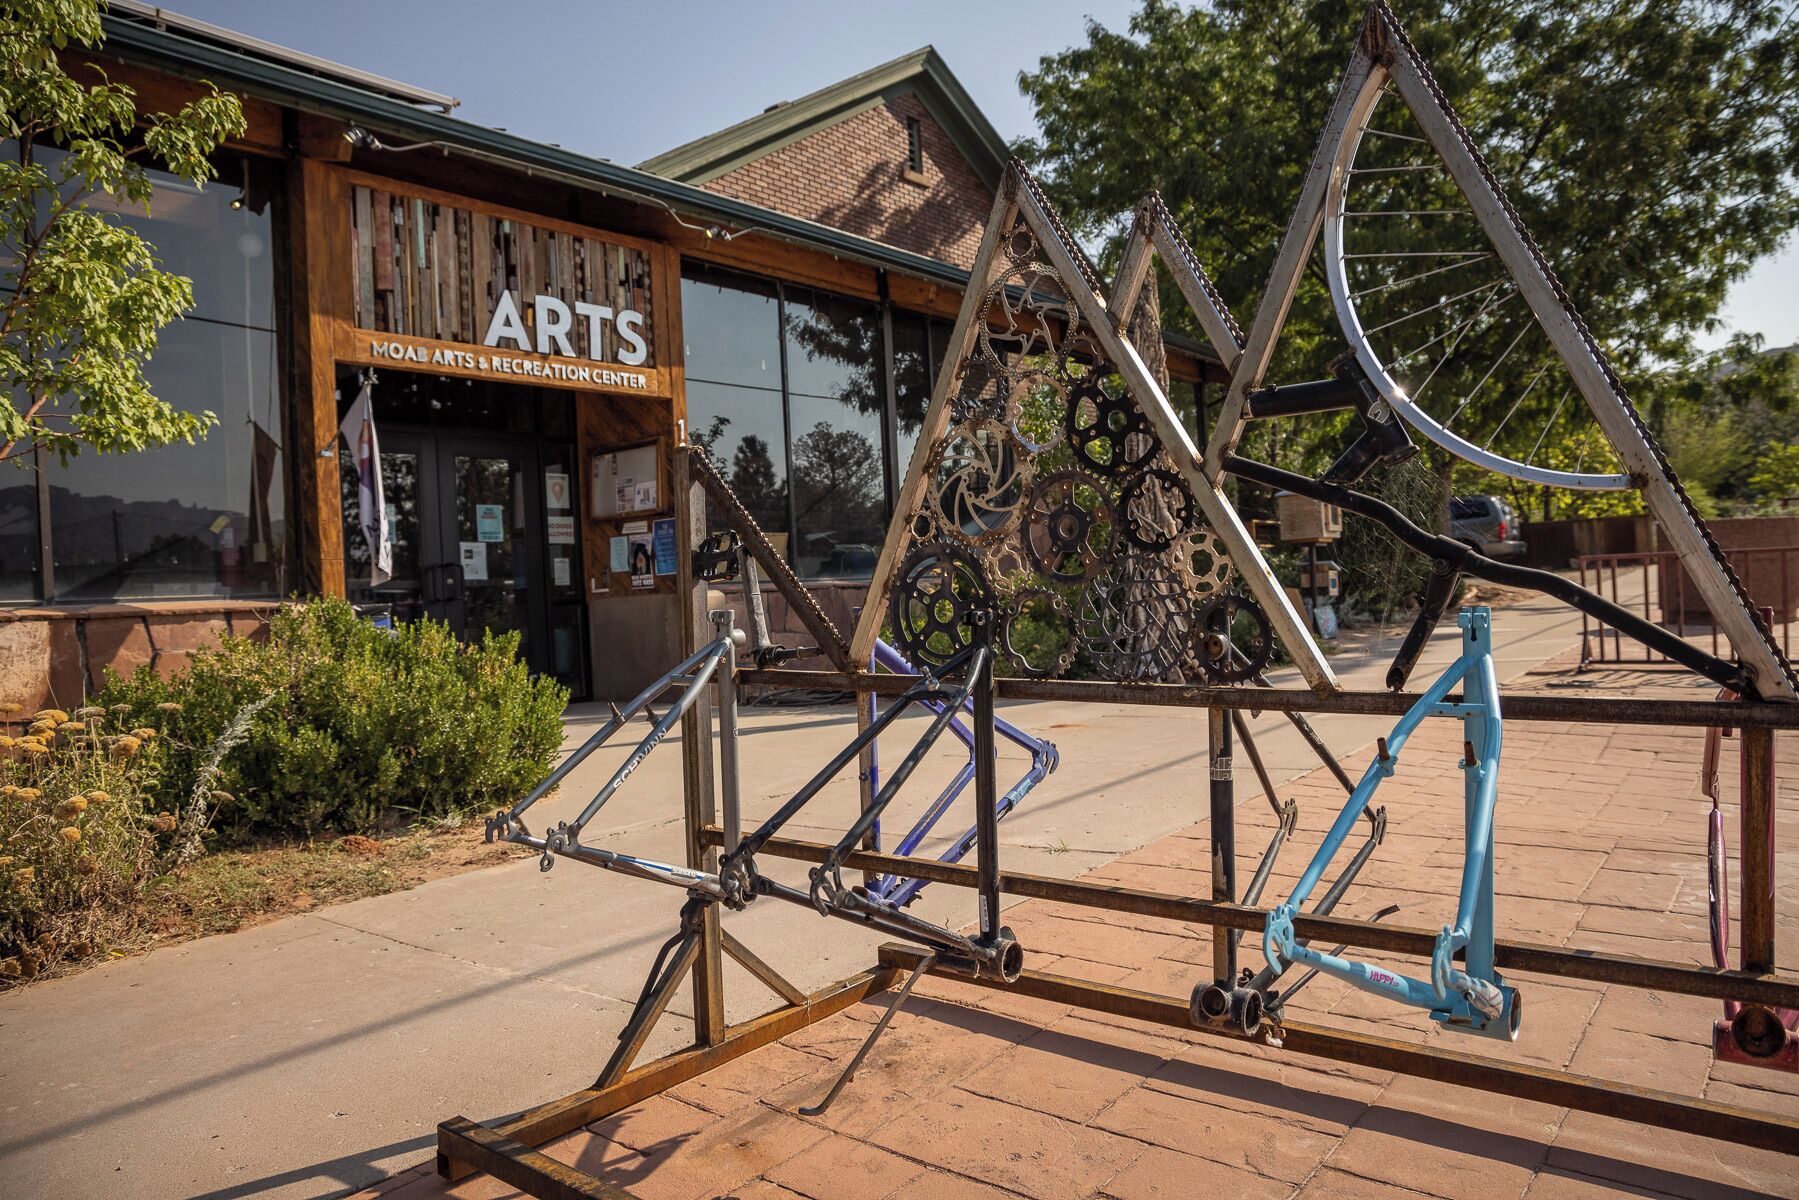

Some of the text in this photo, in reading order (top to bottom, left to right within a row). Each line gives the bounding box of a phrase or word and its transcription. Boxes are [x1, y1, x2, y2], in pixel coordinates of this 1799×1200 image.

[483, 289, 647, 366] ARTS
[371, 340, 647, 389] MOAB ARTS & RECREATION CENTER
[613, 727, 668, 789] SCHWINN
